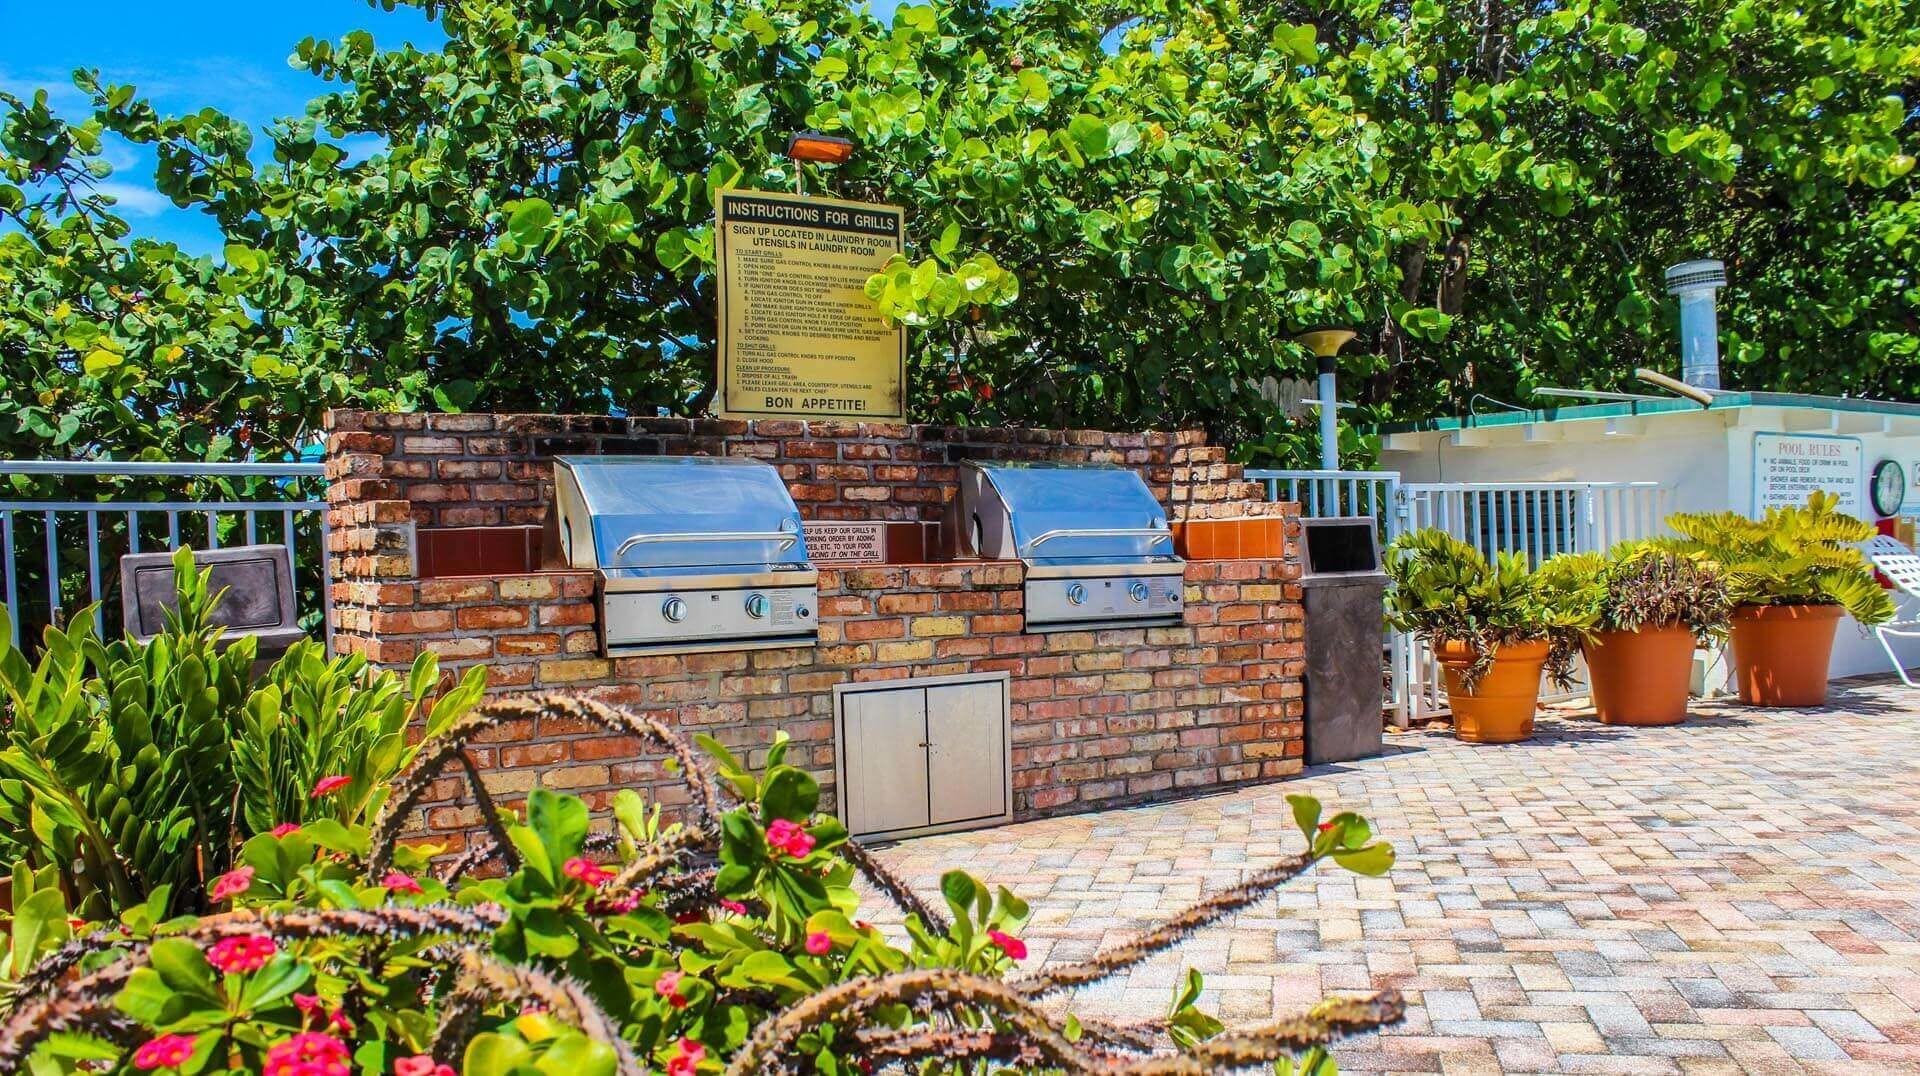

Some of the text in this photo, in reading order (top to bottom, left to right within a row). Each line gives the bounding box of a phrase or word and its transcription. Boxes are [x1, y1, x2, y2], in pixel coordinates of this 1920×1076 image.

[729, 202, 894, 230] INSTRUCTIONS FOR GRILLS
[733, 225, 891, 247] SIGN UP LOCATED IN LAUNDRY ROOM
[753, 237, 874, 256] UTENSILS IN LAUNDRY ROOM
[766, 397, 865, 410] BON APPETITE!
[1779, 443, 1841, 457] POOL RULES
